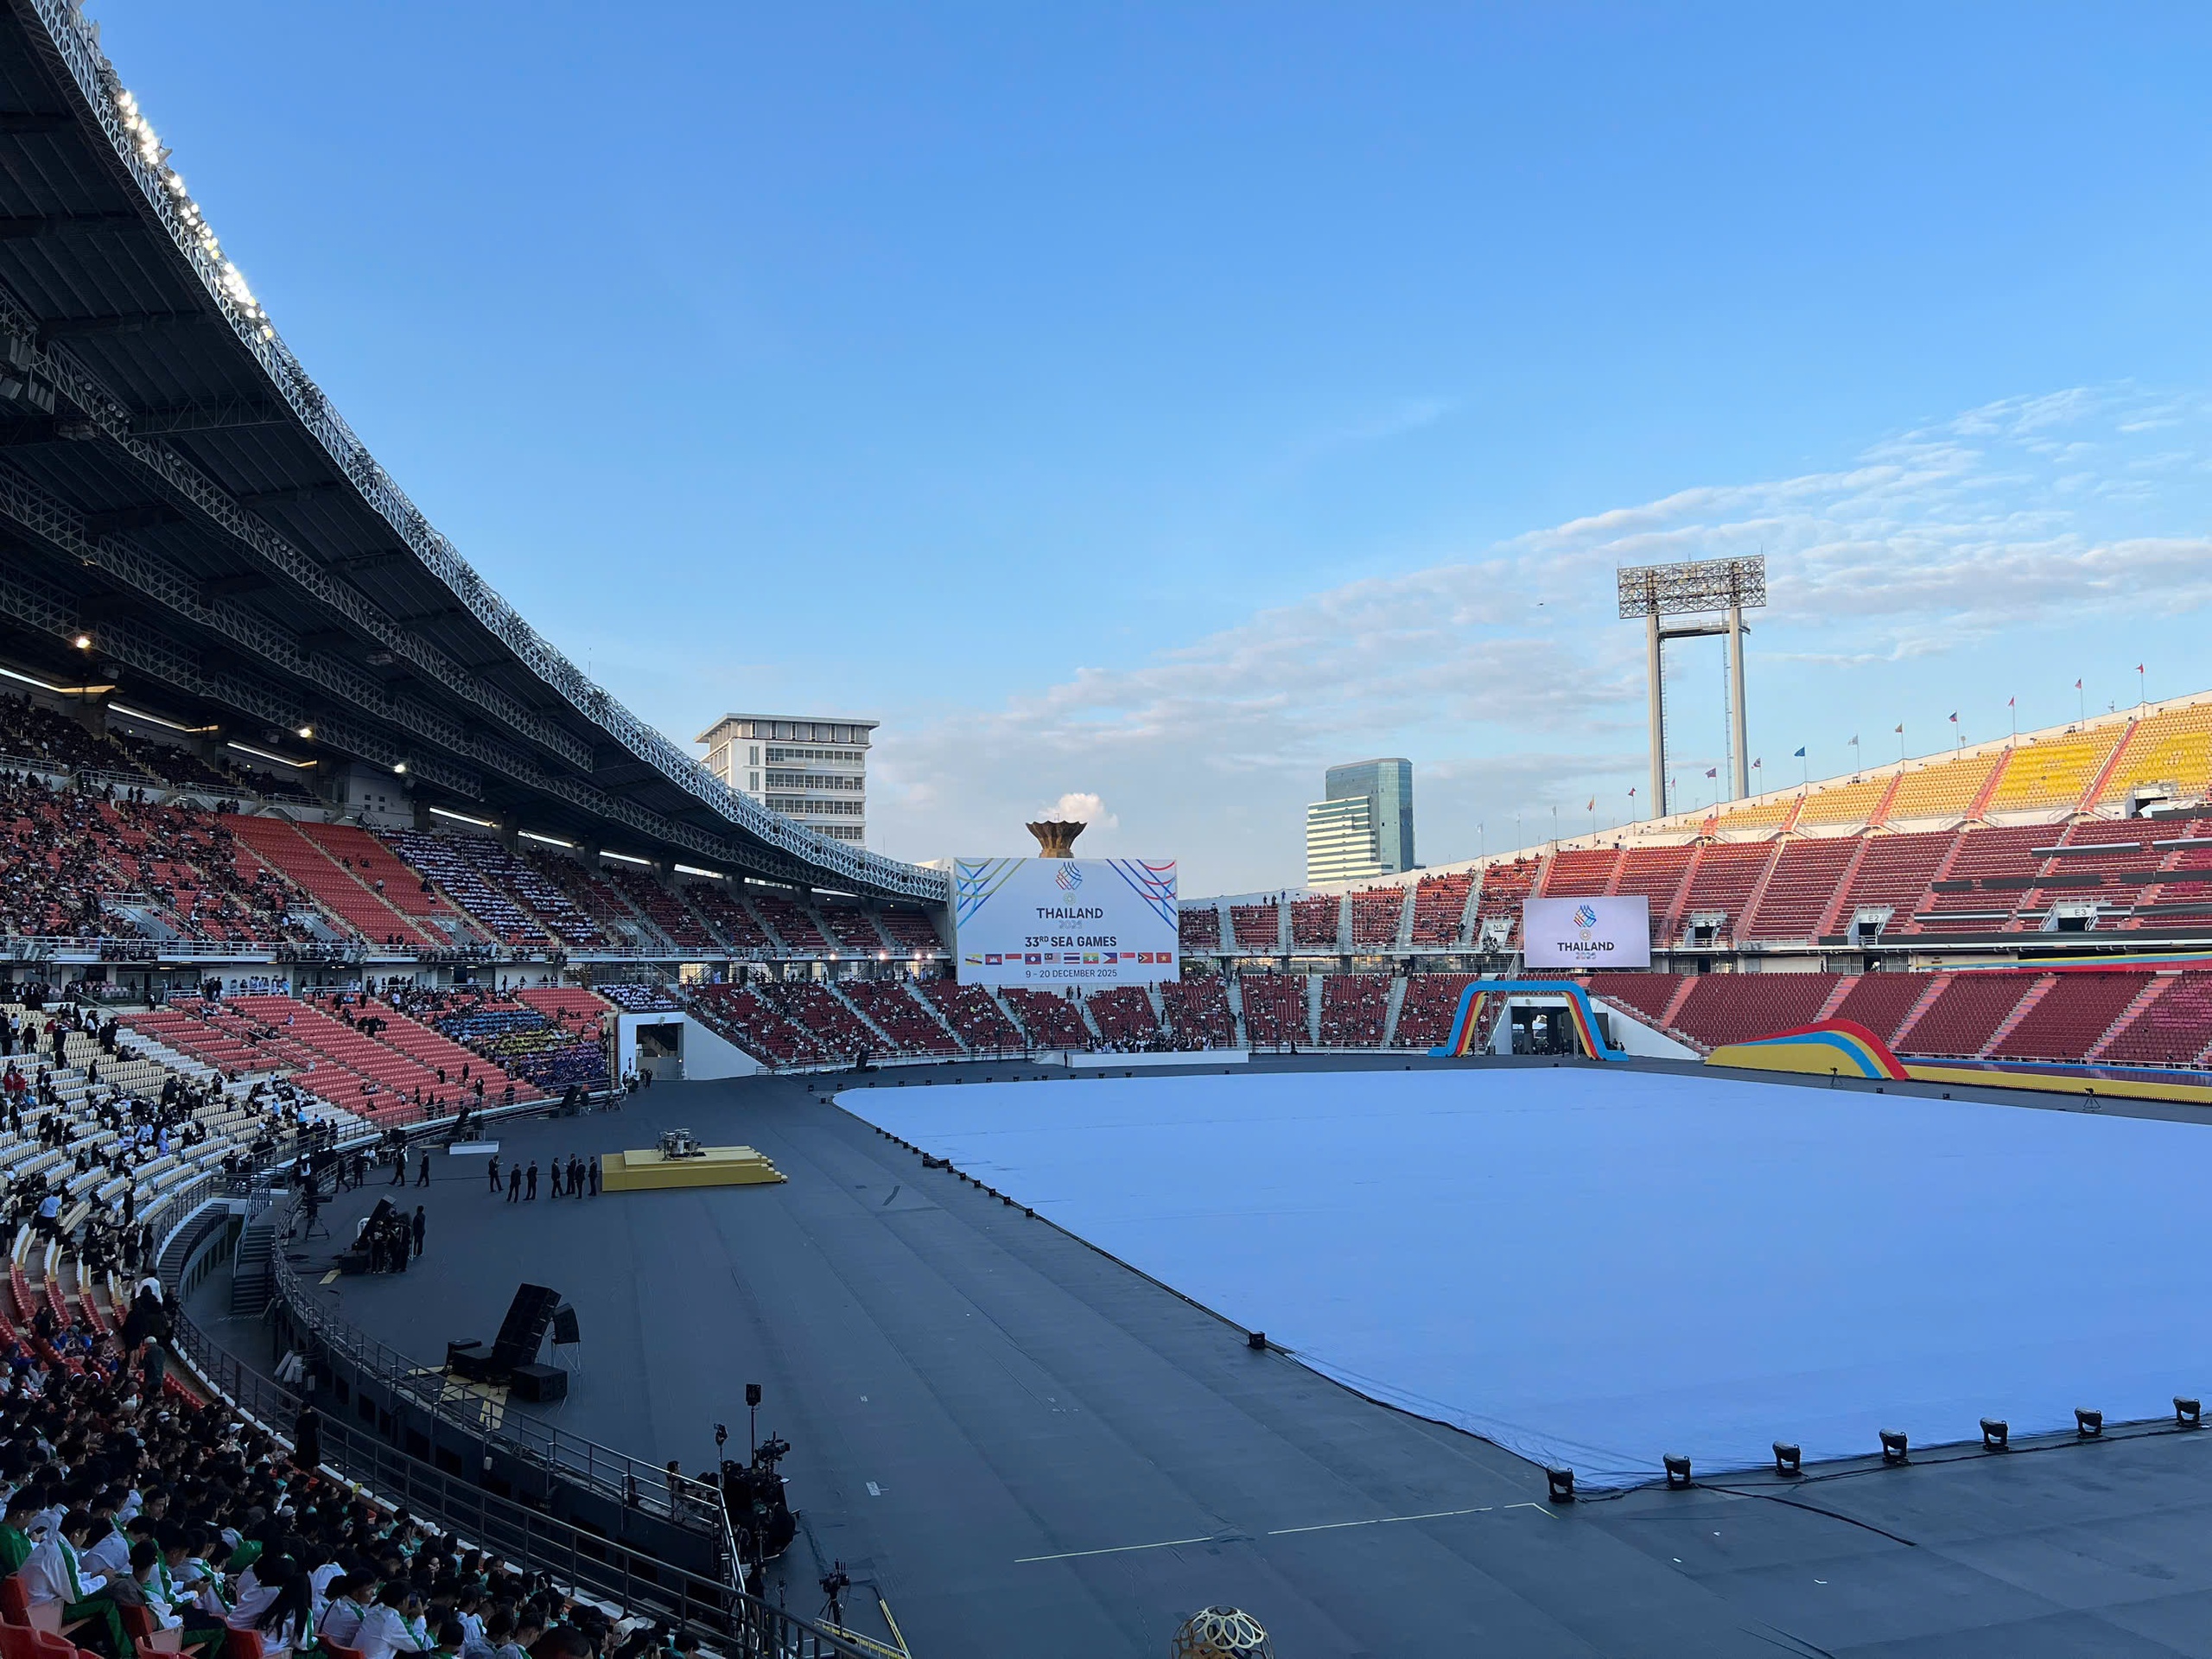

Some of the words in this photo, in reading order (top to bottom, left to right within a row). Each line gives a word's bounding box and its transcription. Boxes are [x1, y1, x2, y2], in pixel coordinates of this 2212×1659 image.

[1036, 907, 1103, 918] THAILAND
[1025, 936, 1049, 948] 33RD
[1051, 937, 1074, 947] SEA
[1077, 936, 1117, 947] GAMES
[1557, 942, 1614, 951] THAILAND
[1025, 969, 1032, 978] 9
[1039, 969, 1051, 978] 20
[1052, 969, 1096, 978] DECEMBER
[1097, 969, 1117, 977] 2025
